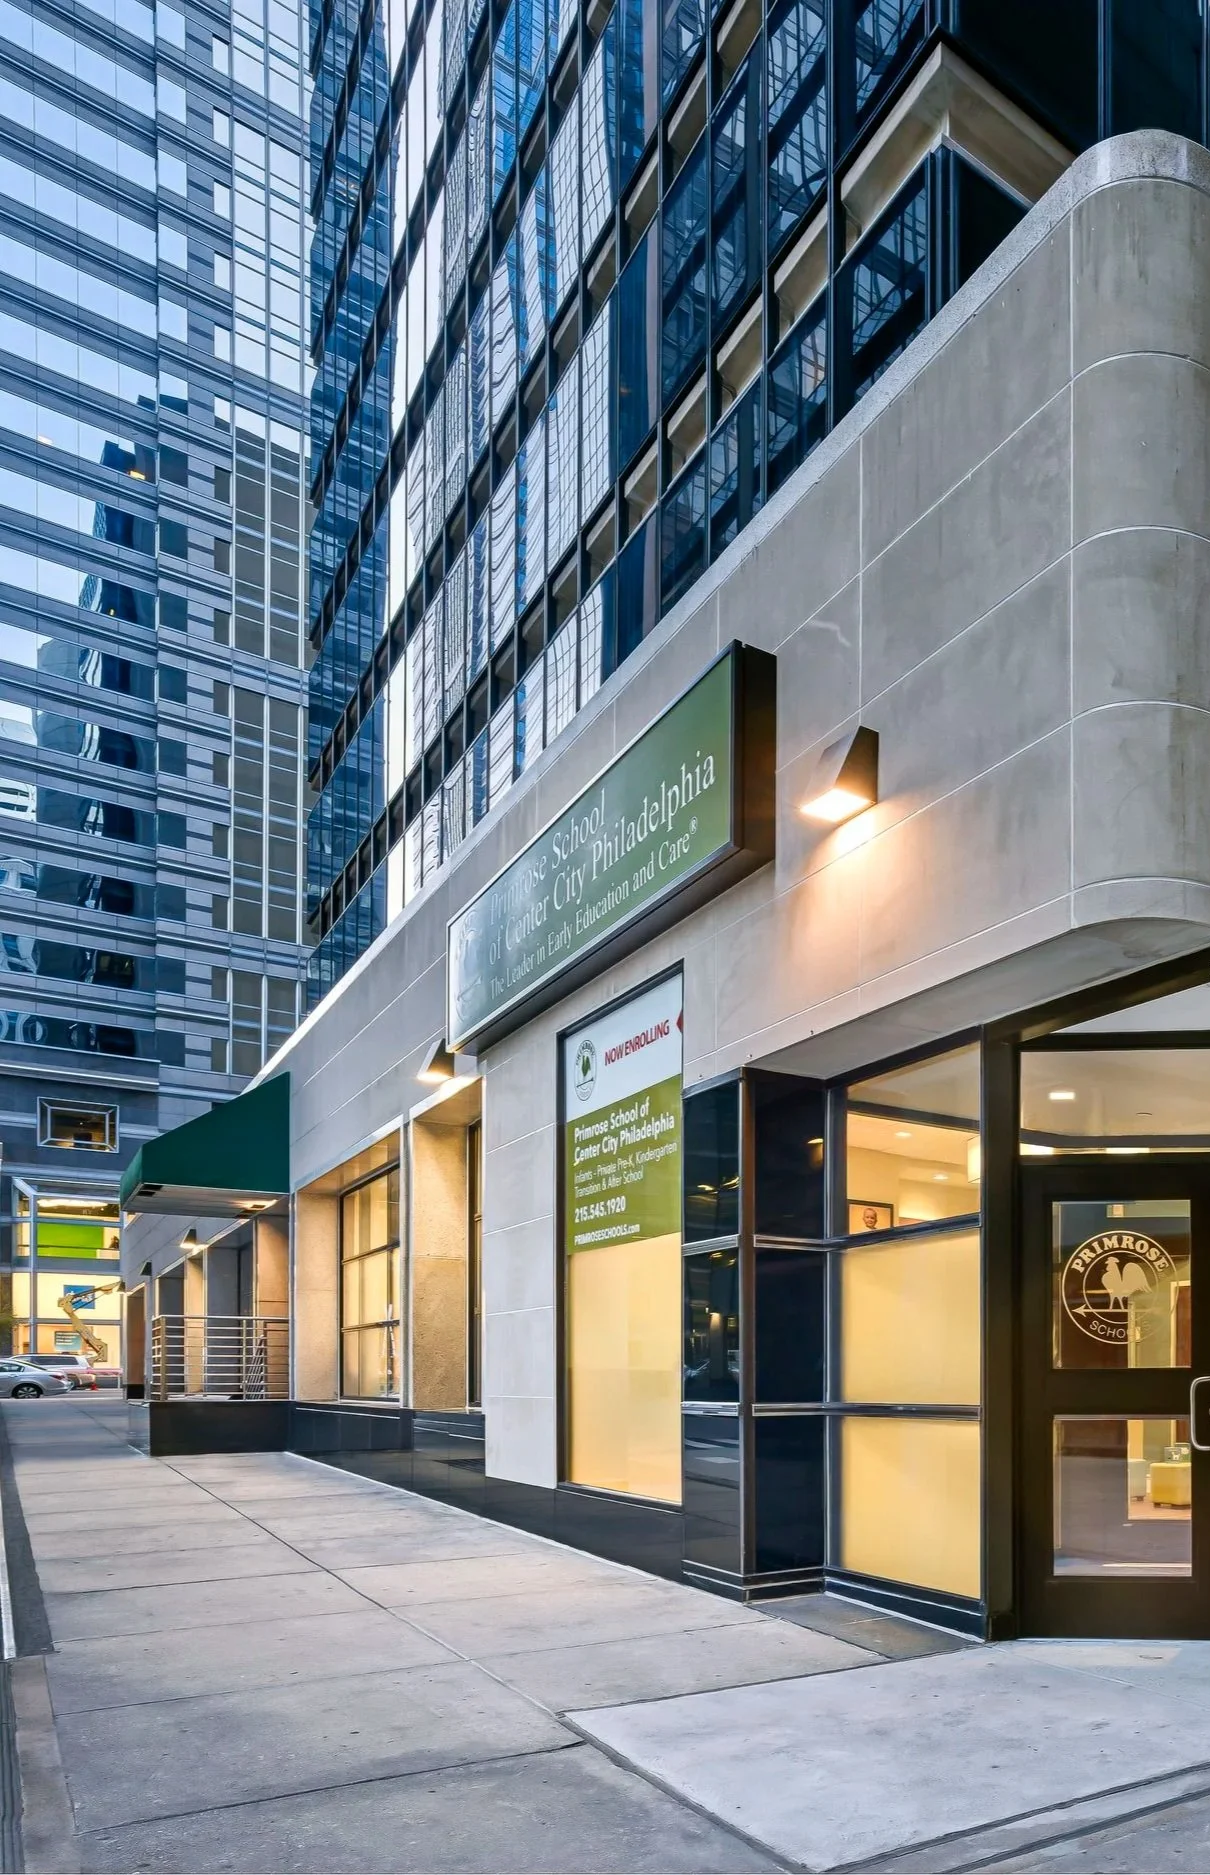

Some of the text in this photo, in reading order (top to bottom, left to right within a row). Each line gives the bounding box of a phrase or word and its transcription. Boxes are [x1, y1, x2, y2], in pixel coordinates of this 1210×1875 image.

[488, 924, 504, 966] of
[504, 894, 550, 950] Center
[553, 862, 587, 912] City
[591, 750, 716, 881] Philadelphia
[489, 787, 606, 926] Primrose School
[490, 976, 505, 999] The
[506, 955, 535, 988] Leader
[536, 944, 546, 965] in
[547, 921, 573, 957] Early
[575, 880, 630, 935] Education
[632, 852, 655, 892] and
[604, 1043, 625, 1067] NOW
[624, 1019, 670, 1057] ENROLLING
[574, 1096, 650, 1144] Primrose School of
[574, 1112, 675, 1163] Center City Philadelphia
[601, 1177, 607, 1191] &
[622, 1165, 644, 1185] School
[574, 1195, 627, 1223] 215.545.1920
[574, 1223, 640, 1246] PRIMROSESCHOOLS.com
[1071, 1235, 1170, 1274] PRIMROSE
